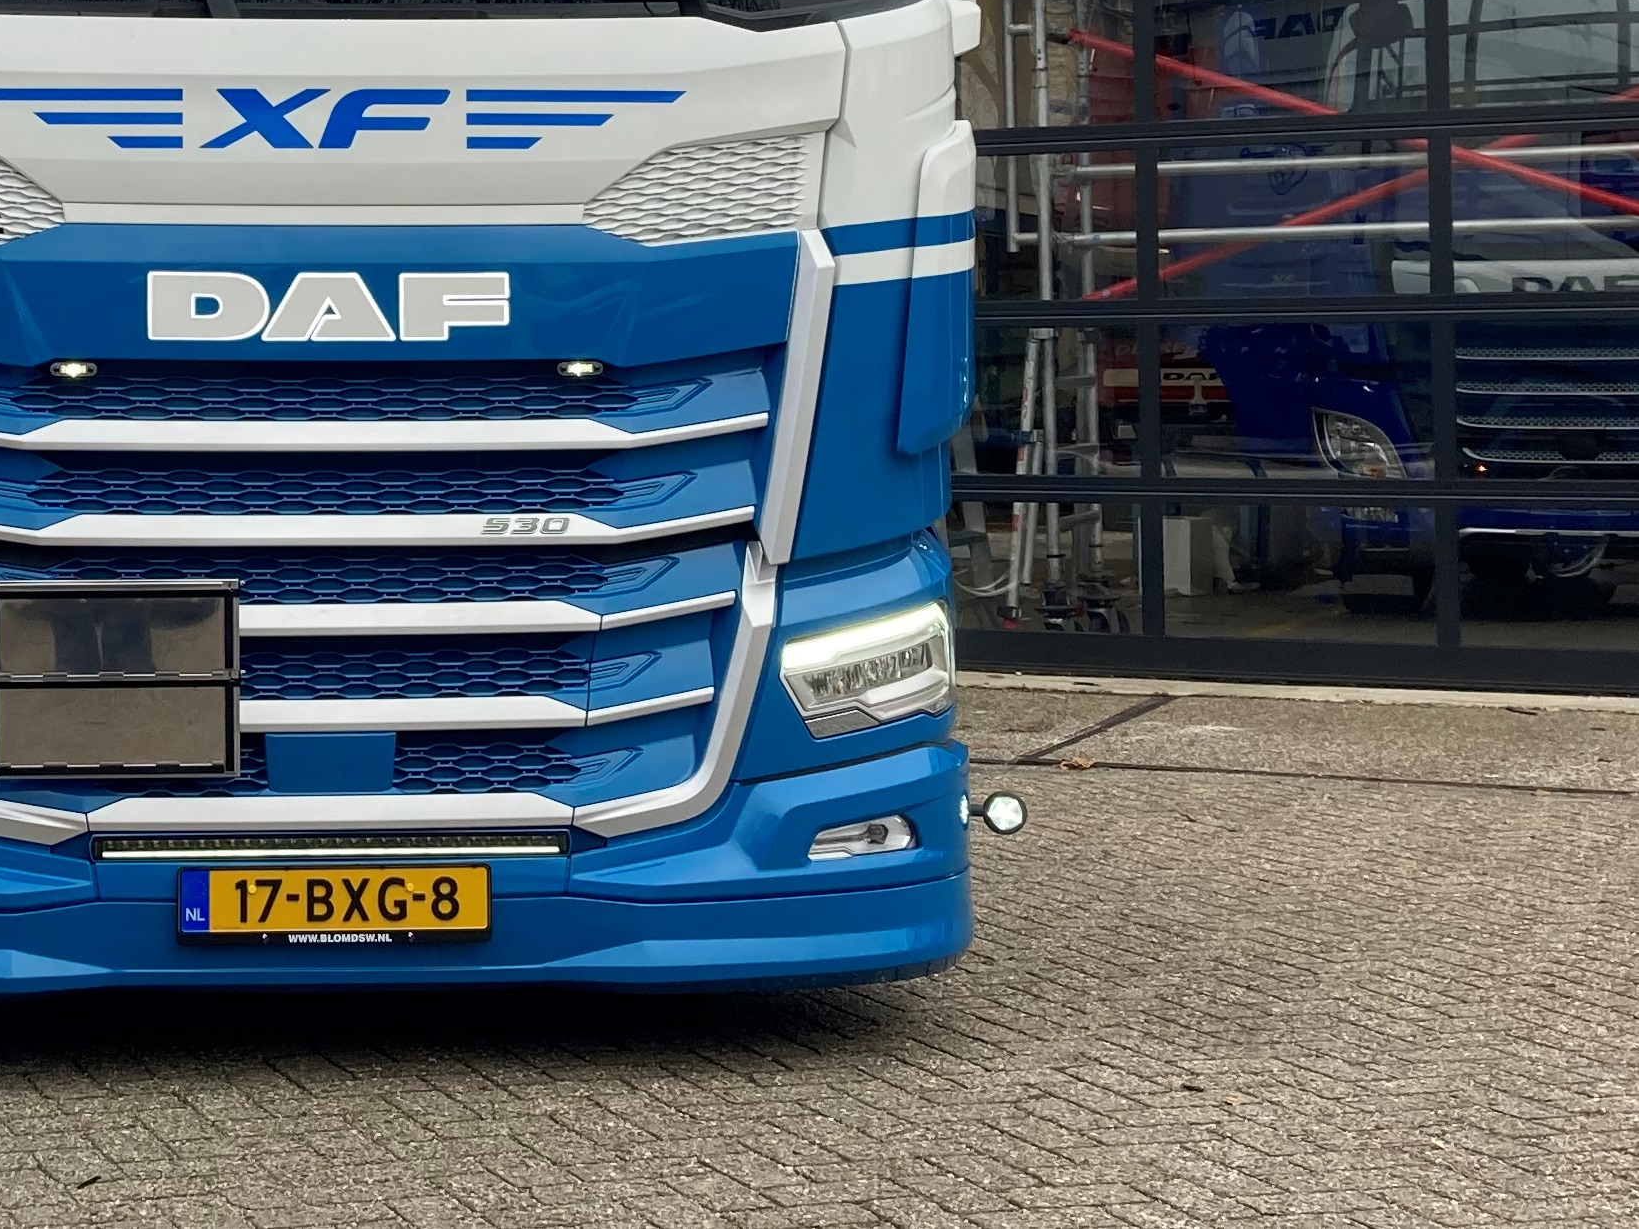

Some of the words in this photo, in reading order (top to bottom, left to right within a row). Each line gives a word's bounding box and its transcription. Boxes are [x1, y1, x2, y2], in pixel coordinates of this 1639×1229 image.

[199, 88, 451, 149] XF
[1511, 275, 1639, 292] DAF
[147, 271, 510, 342] DAF
[481, 517, 570, 535] 530
[235, 876, 460, 923] 17-BXG-8
[185, 908, 205, 922] NL
[288, 933, 393, 943] WWW.BLOMDSW.NL
